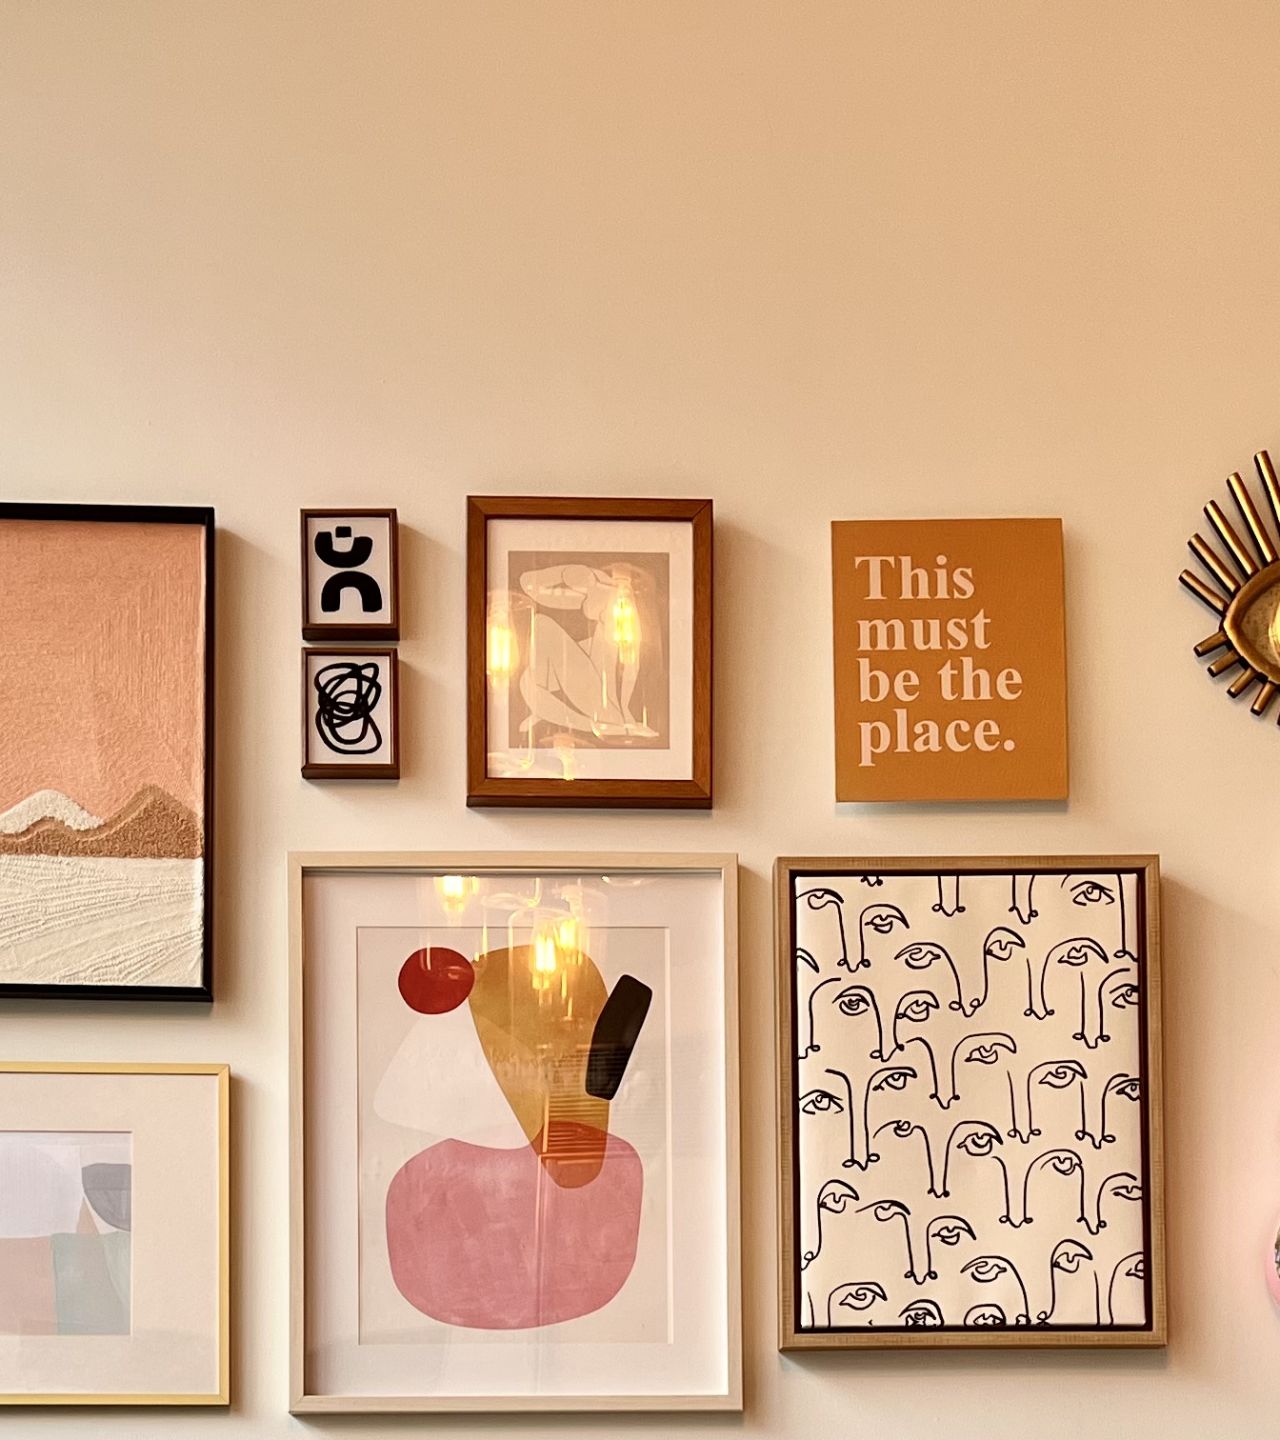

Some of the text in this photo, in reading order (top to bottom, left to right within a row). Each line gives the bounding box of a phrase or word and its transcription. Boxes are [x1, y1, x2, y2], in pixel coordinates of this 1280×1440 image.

[854, 554, 974, 600] This
[856, 609, 992, 650] must
[856, 657, 1022, 702] be the
[858, 708, 1015, 766] place.
